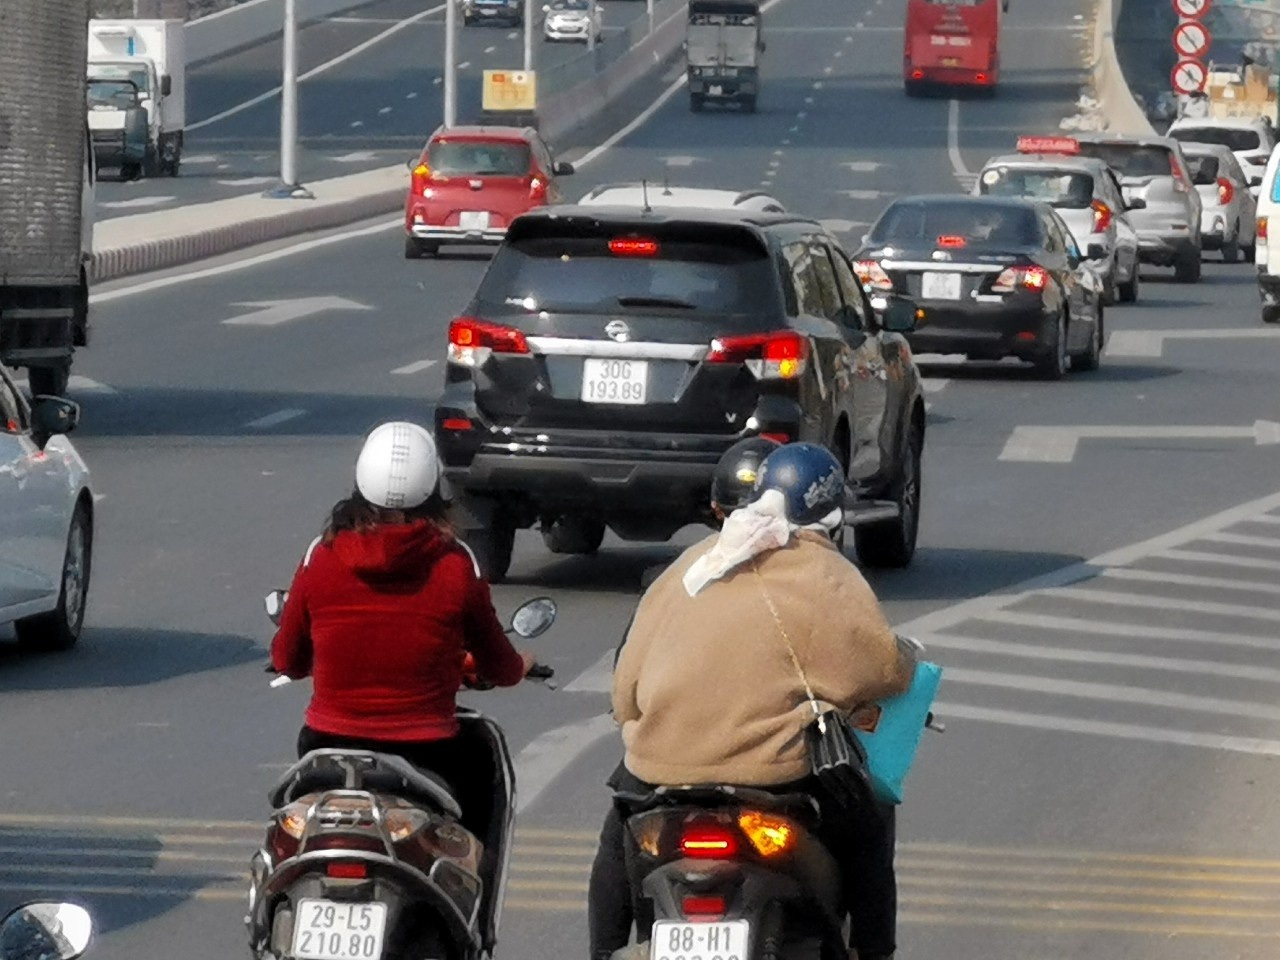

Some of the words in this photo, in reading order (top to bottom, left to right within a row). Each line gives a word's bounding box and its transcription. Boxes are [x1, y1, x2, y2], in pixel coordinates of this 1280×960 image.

[600, 360, 631, 379] 30G
[589, 380, 642, 400] 193.89
[311, 905, 372, 931] 29-L5
[300, 930, 376, 957] 210.80
[668, 926, 731, 952] 88-H1
